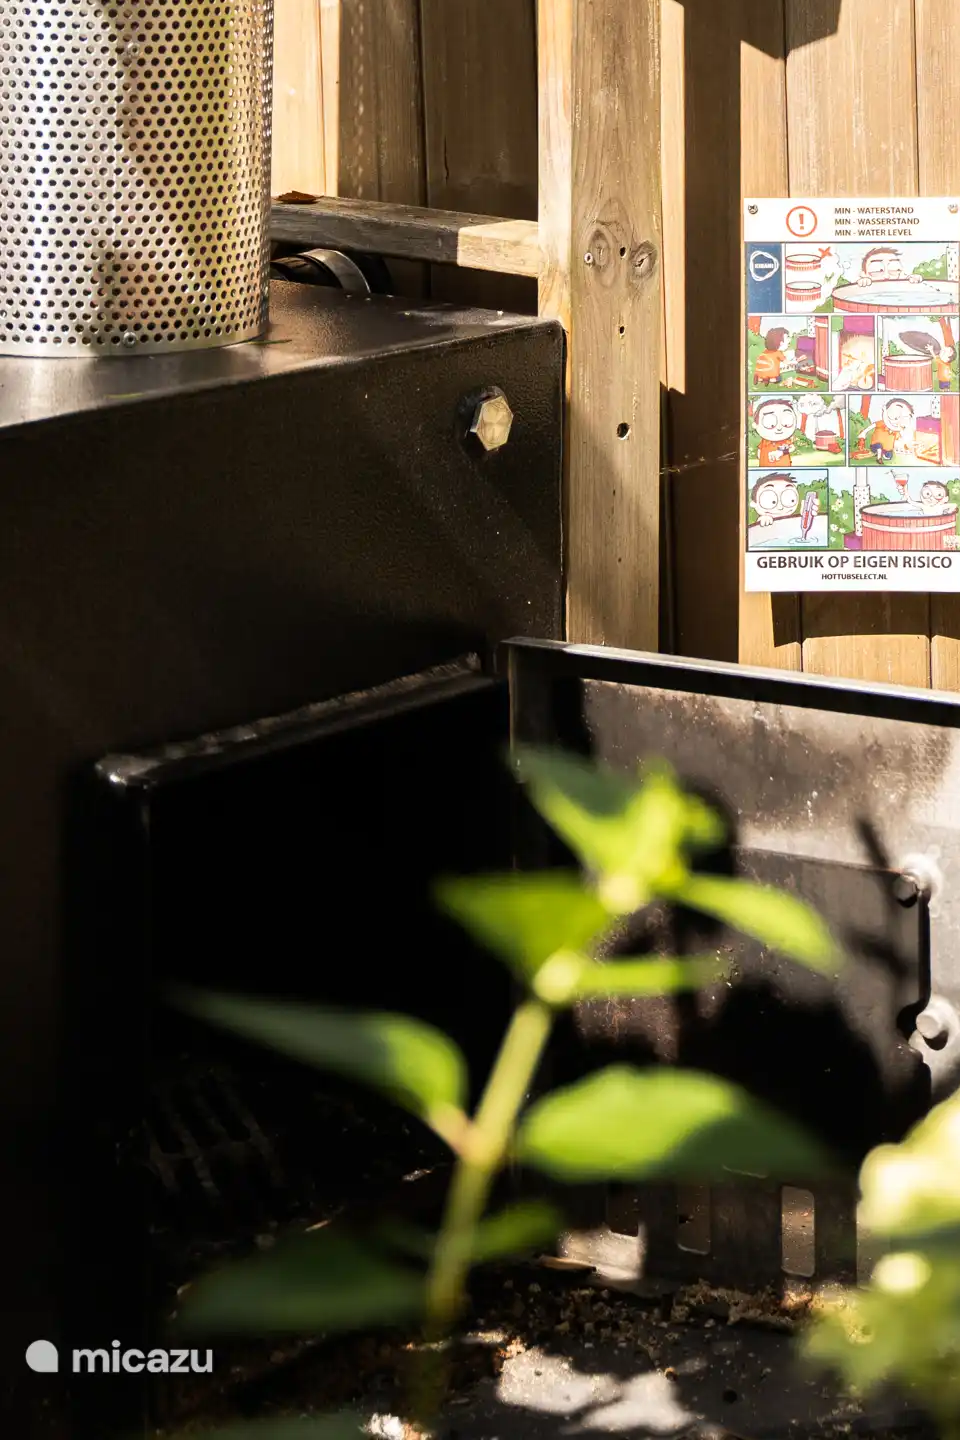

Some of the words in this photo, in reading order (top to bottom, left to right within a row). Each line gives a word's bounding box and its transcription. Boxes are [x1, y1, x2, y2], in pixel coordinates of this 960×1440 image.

[857, 206, 914, 214] WATERSTAND
[834, 217, 851, 225] MIN
[857, 217, 920, 225] WASSERSTAND
[887, 228, 912, 236] LEVEL
[756, 556, 824, 569] GEBRUIK
[828, 556, 849, 568] OP
[853, 556, 898, 568] EIGEN
[903, 556, 952, 569] RISICO
